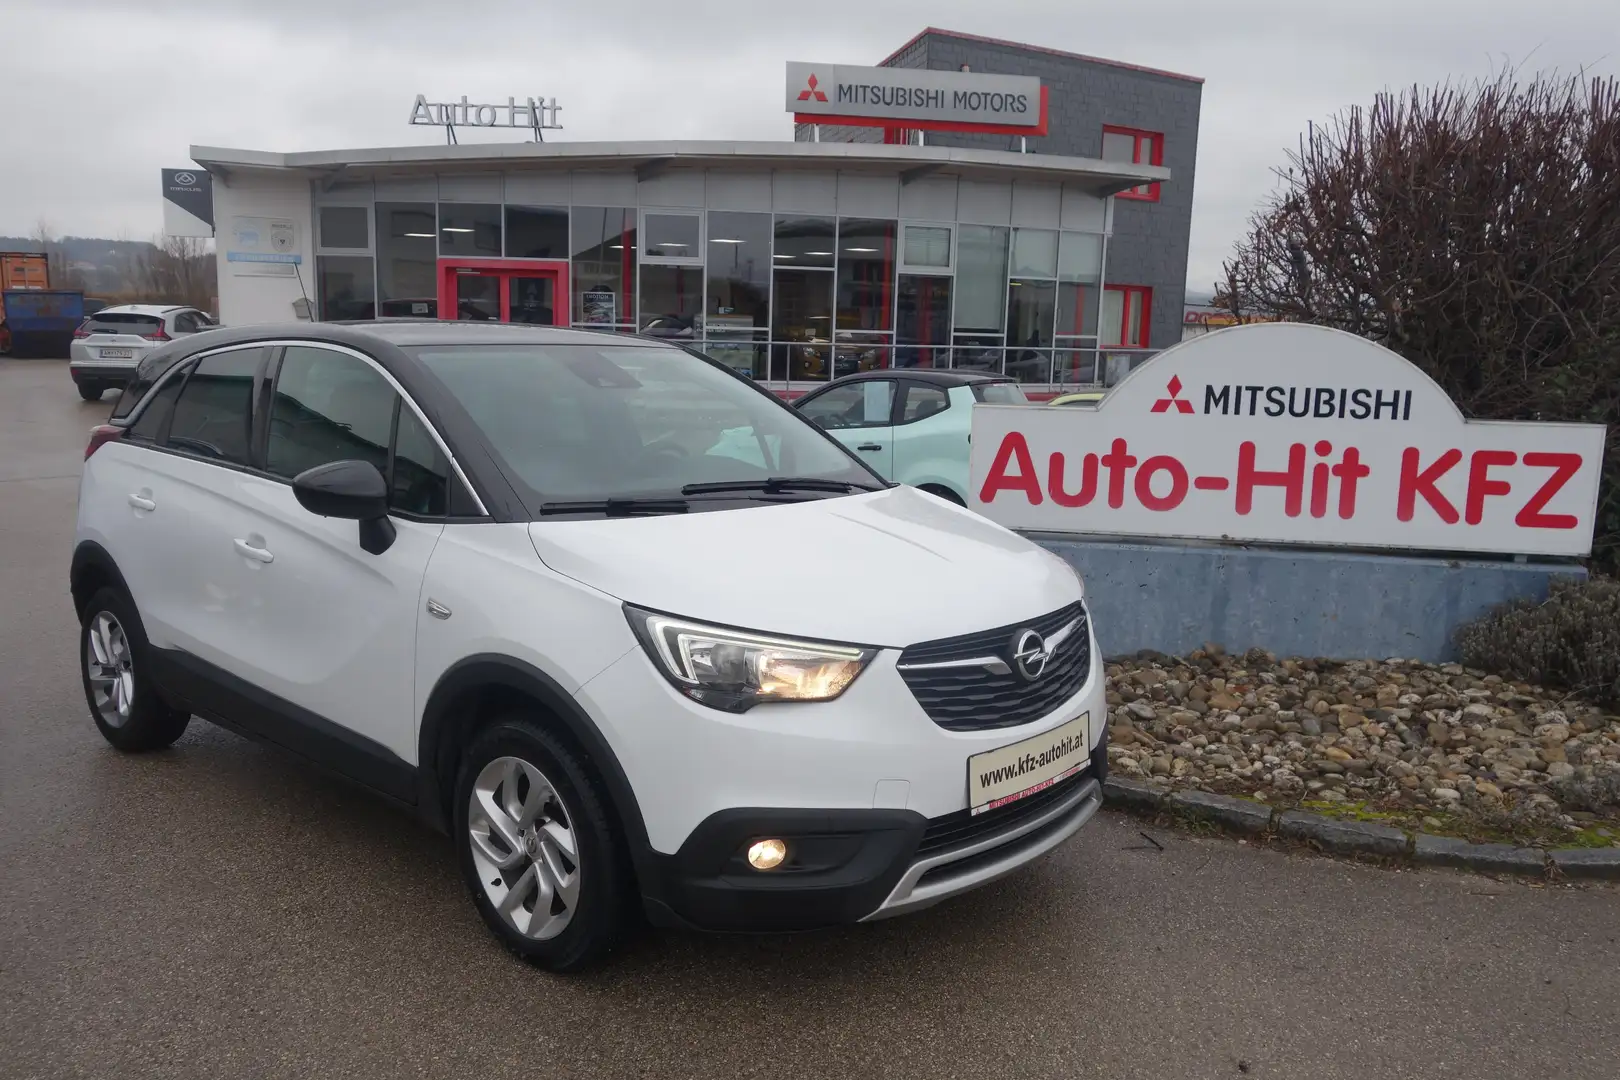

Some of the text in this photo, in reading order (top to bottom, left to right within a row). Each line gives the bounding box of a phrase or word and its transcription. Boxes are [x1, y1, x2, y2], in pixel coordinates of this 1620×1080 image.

[408, 94, 563, 129] Auto Hit
[838, 84, 1028, 113] MITSUBISHI MOTORS
[1203, 383, 1413, 421] MITSUBISHI
[979, 431, 1583, 530] Auto-Hit KFZ
[980, 730, 1084, 789] www.kfz-autohit.at
